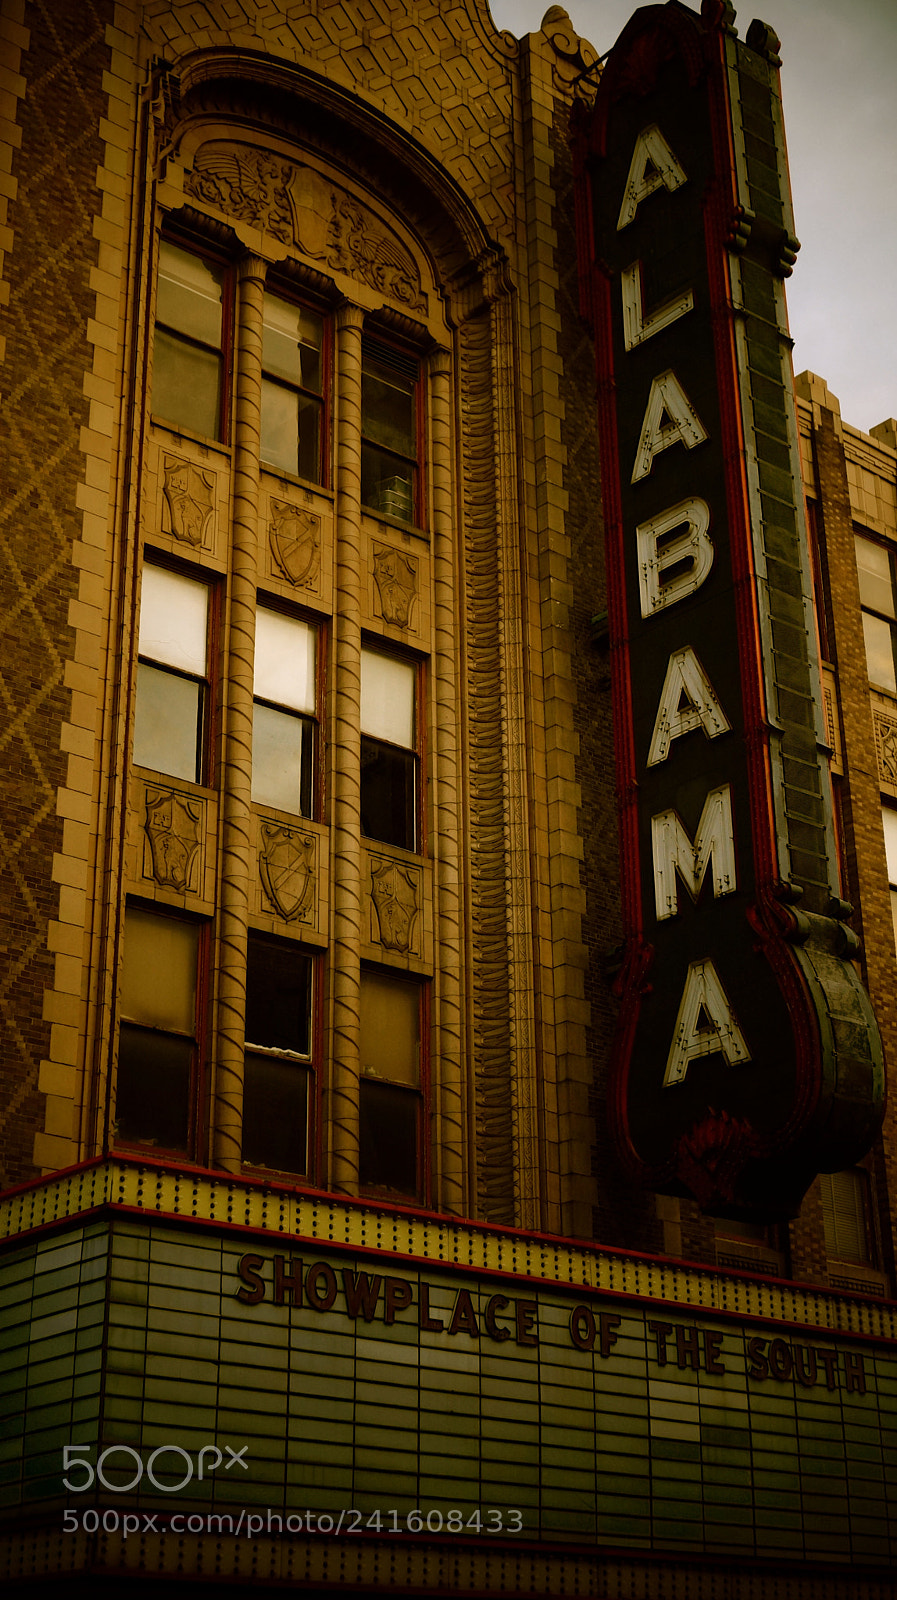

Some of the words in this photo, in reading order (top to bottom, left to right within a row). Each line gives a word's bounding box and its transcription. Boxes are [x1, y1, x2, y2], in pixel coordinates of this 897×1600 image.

[616, 122, 753, 1089] ALABAMA
[234, 1252, 538, 1347] SHOWPLACE
[569, 1305, 621, 1358] OF
[650, 1321, 725, 1376] THE
[748, 1337, 867, 1394] SOUTH
